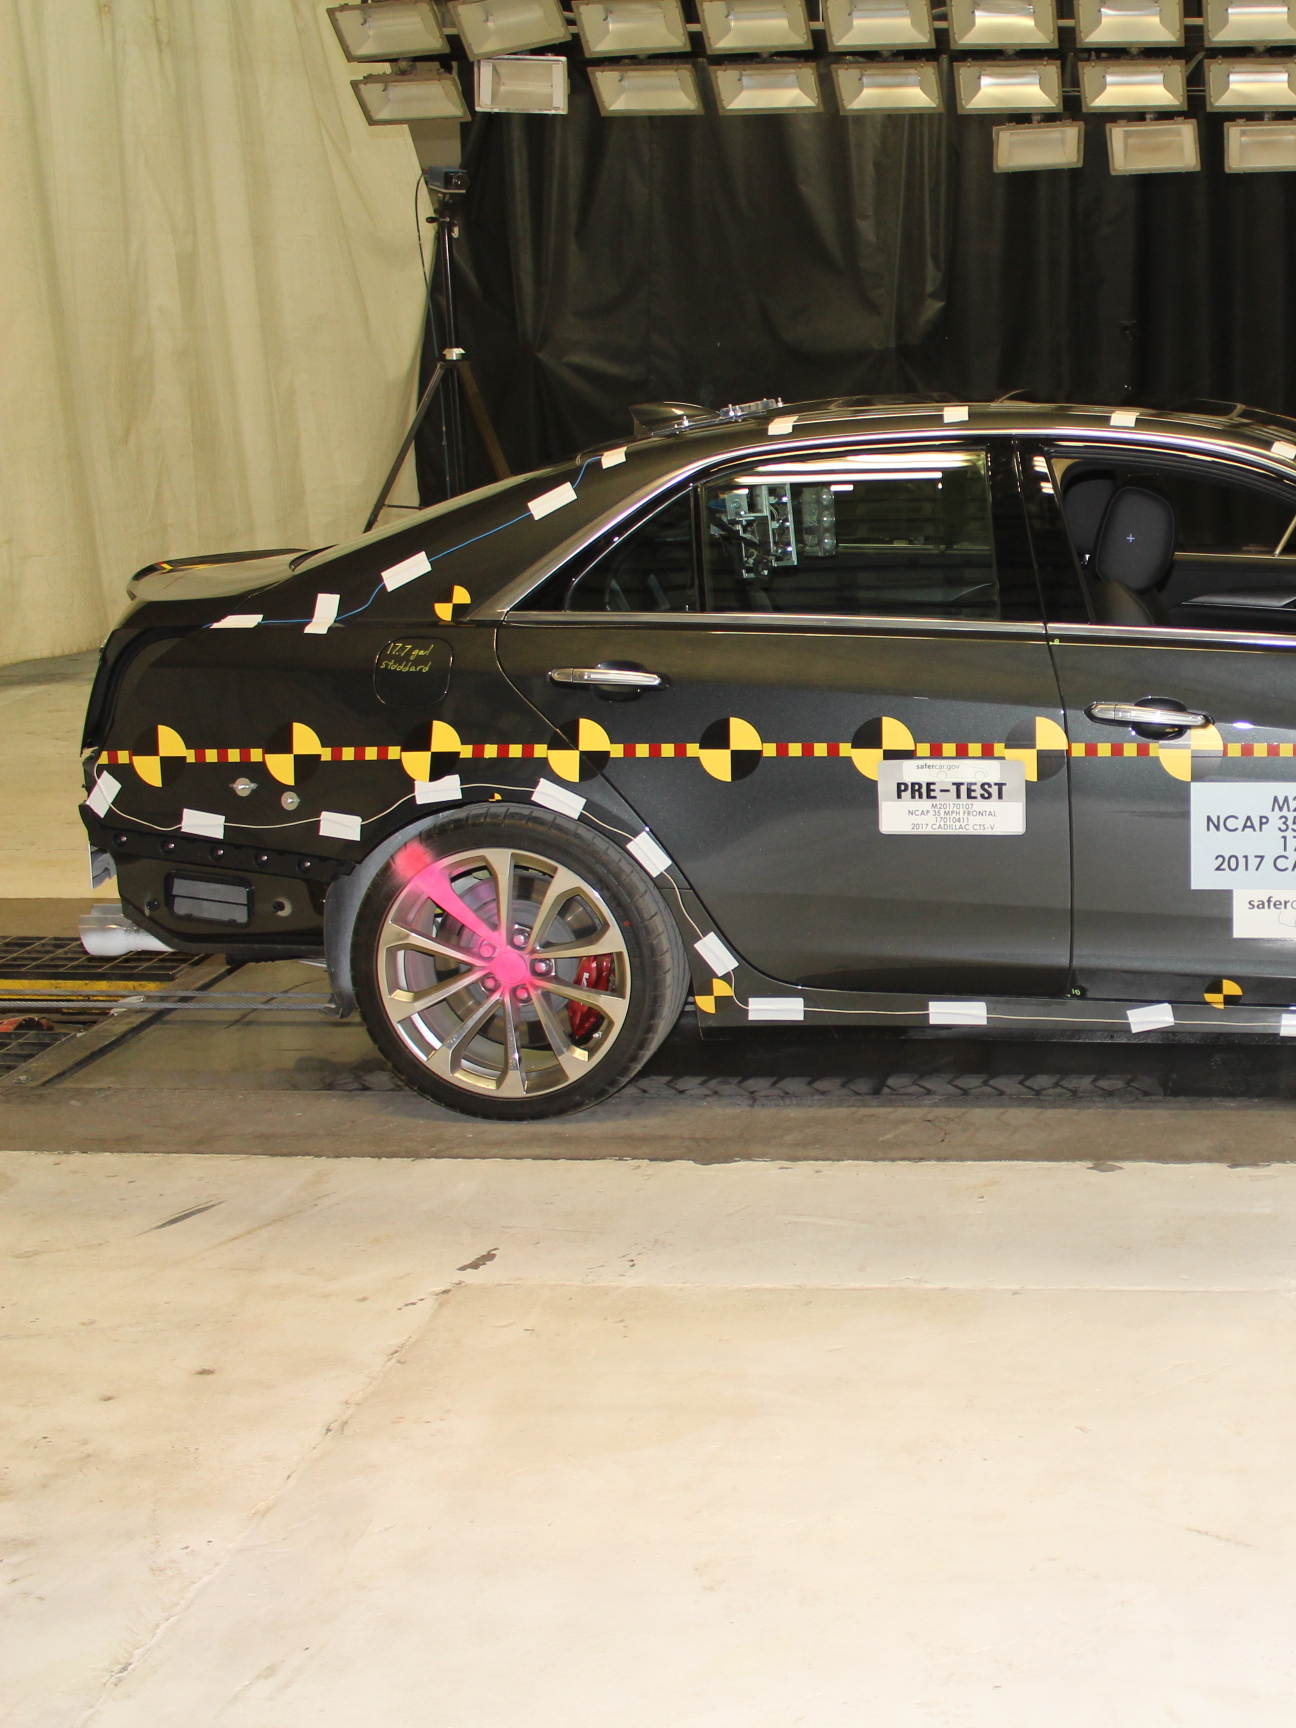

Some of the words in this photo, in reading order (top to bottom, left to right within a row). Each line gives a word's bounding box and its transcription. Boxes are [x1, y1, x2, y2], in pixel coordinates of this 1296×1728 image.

[387, 643, 413, 657] 17.7
[916, 763, 960, 771] safercar.gov
[896, 782, 1007, 800] PRE-TEST
[931, 823, 970, 831] CADILLAC
[1206, 815, 1270, 832] NCAP
[1214, 854, 1265, 872] 2017
